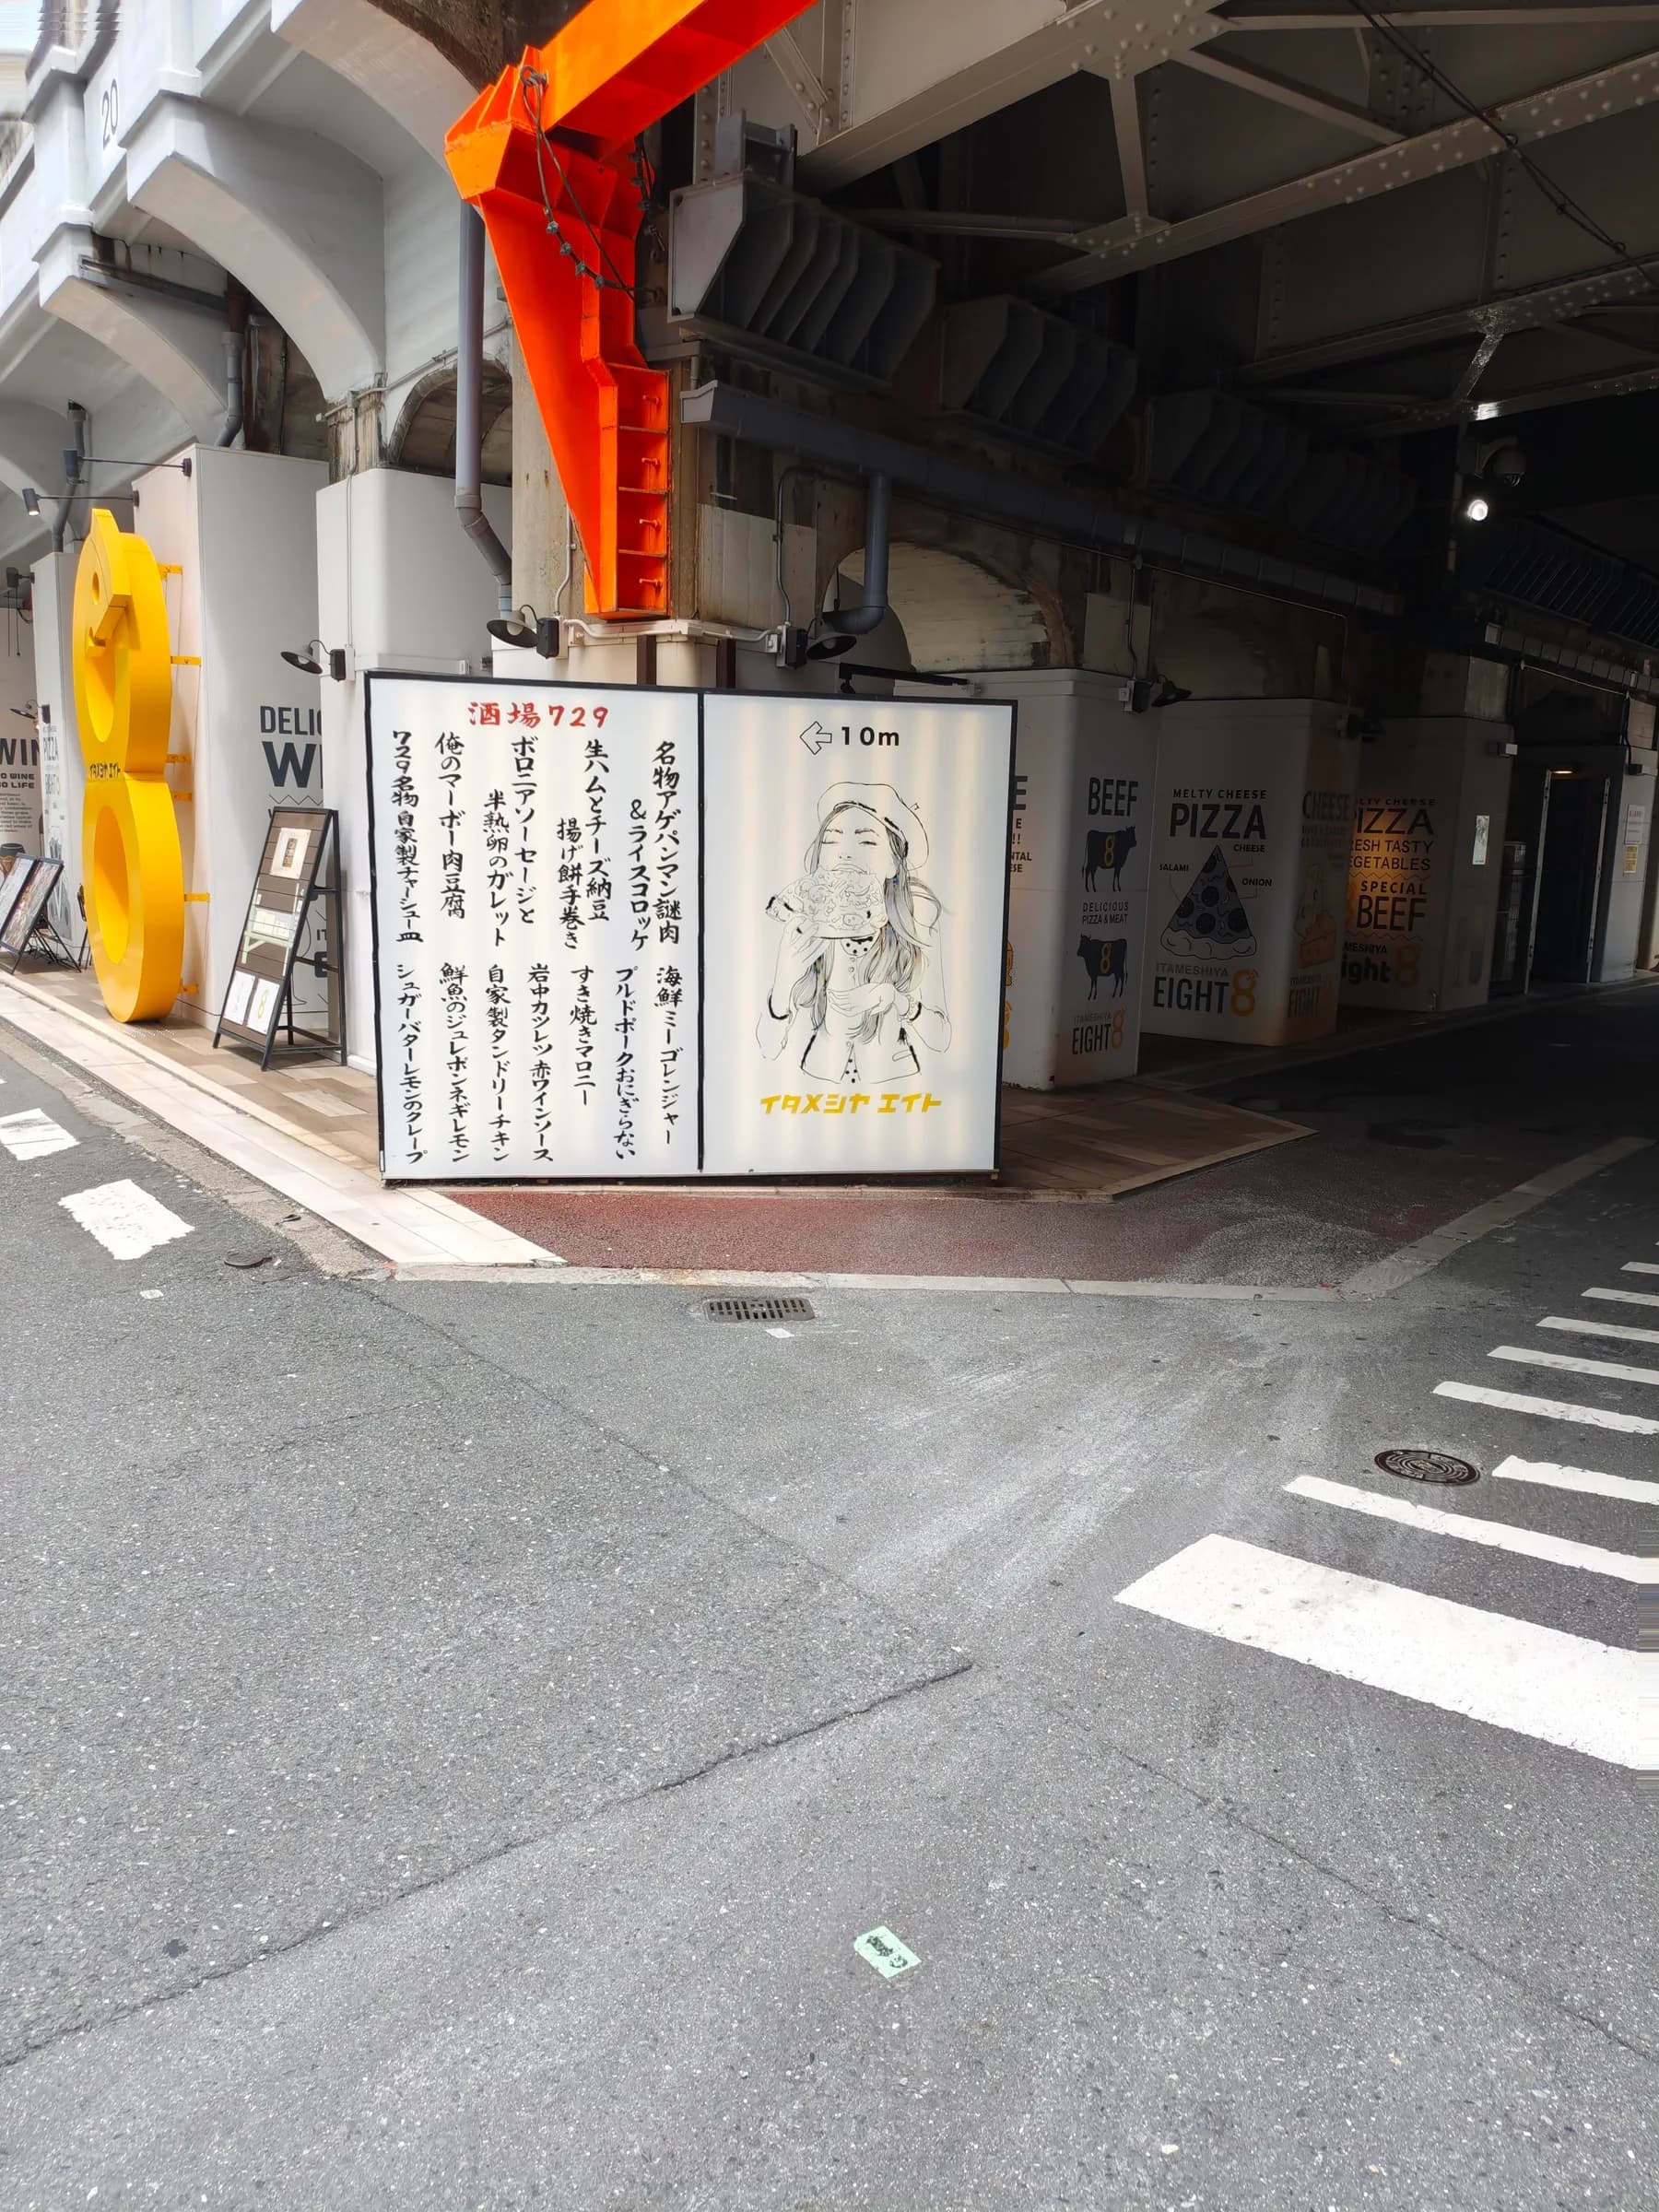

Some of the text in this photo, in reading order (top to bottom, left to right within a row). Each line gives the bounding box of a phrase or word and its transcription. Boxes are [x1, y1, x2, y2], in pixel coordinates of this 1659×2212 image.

[101, 78, 119, 149] 20
[841, 725, 900, 747] 10m
[11, 782, 35, 790] LIFE
[1088, 777, 1139, 817] BEEF
[1173, 789, 1267, 800] MELTY CHEESE
[435, 732, 465, 919] 俺のマーボー肉豆腐
[511, 735, 538, 924] ボロニアソーセージと
[584, 739, 612, 921] 生ハムとチーズ納豆
[1170, 802, 1267, 840] PIZZA
[1354, 806, 1435, 836] IZZA
[1233, 843, 1265, 853] CHEESE
[1384, 840, 1435, 854] TASTY
[483, 789, 513, 947] 半熟卵のガレット
[556, 818, 586, 949] 揚げ餅手巻き
[1241, 877, 1273, 888] ONION
[1360, 880, 1428, 896] SPECIAL
[1082, 901, 1129, 913] DELICIOUS
[1082, 914, 1102, 925] PIZZA
[1109, 913, 1129, 924] MEAT
[1357, 894, 1428, 933] BEEF
[1156, 963, 1229, 978] ITAMESHIYA
[1154, 977, 1231, 1015] EIGHT
[570, 965, 598, 1106] すき焼きマロニー
[1072, 1023, 1112, 1055] EIGHT
[486, 964, 512, 1161] 自家製タンドリーチキン
